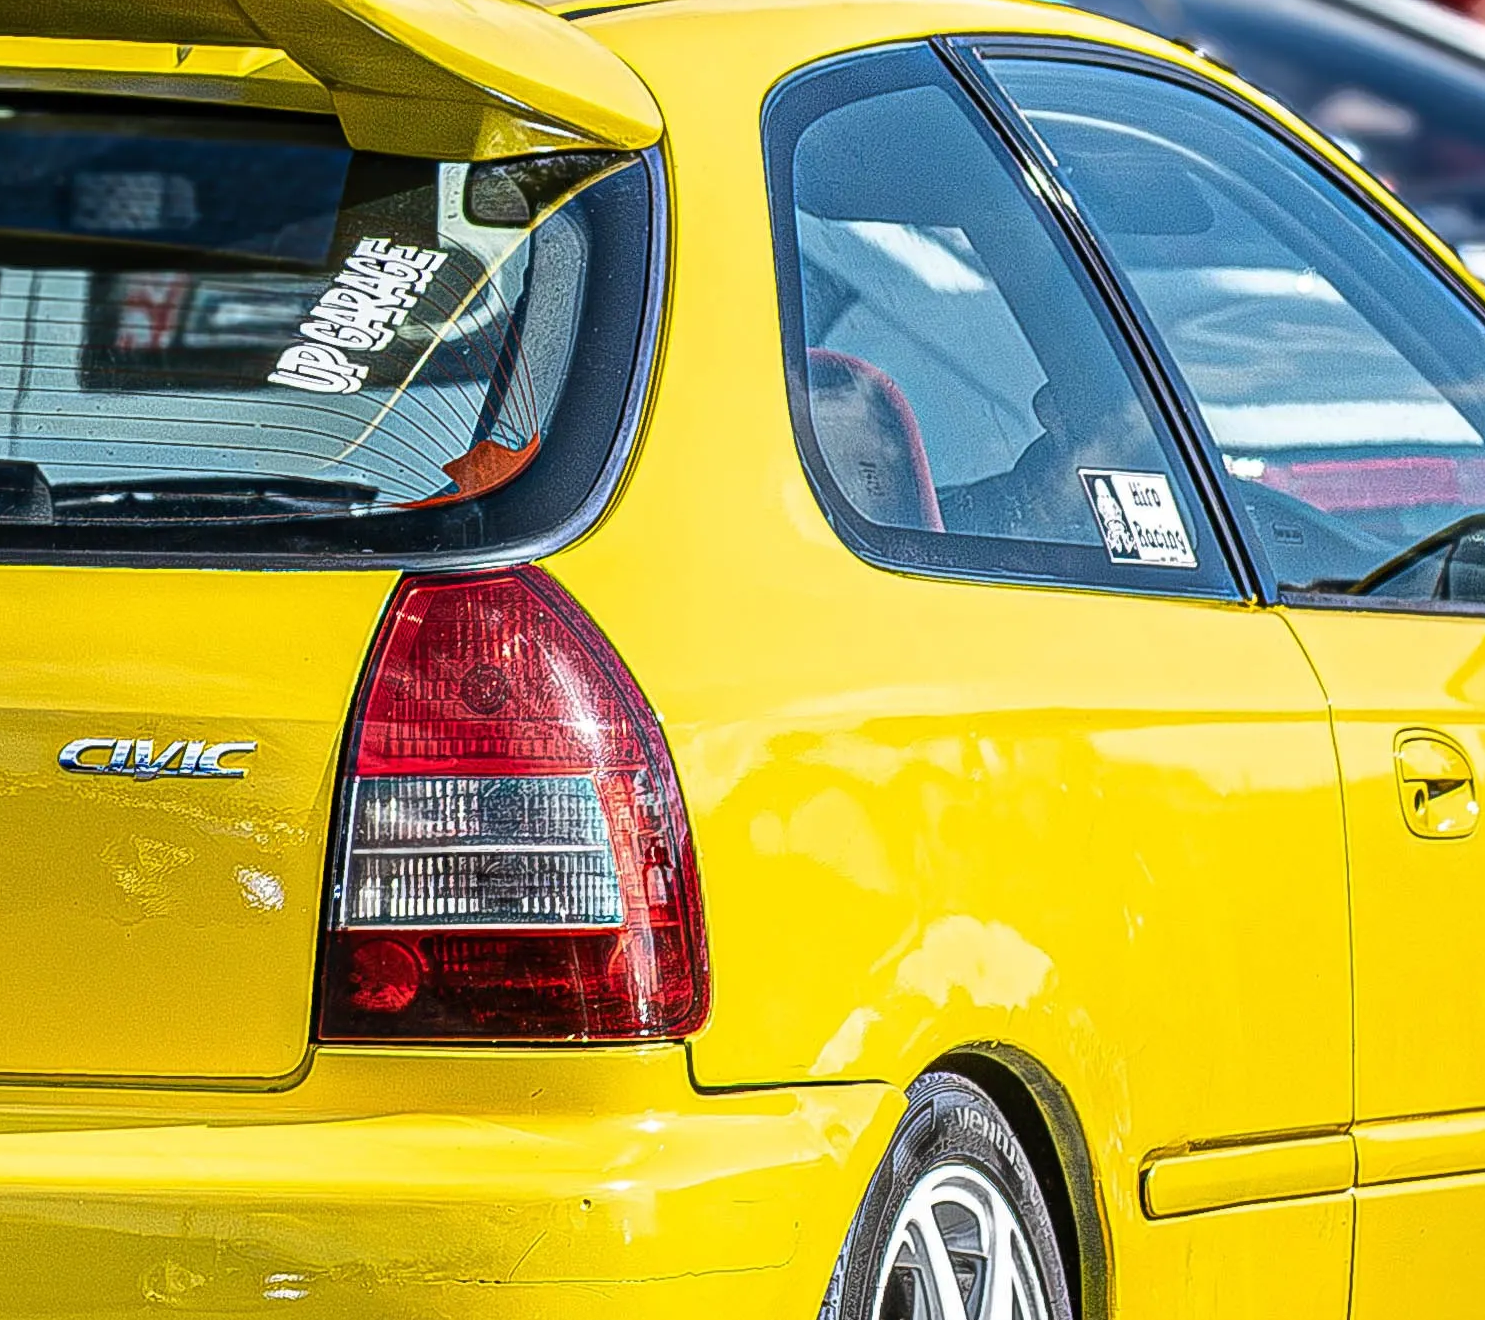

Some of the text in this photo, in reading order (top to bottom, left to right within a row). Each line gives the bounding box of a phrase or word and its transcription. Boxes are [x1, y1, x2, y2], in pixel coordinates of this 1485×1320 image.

[268, 237, 448, 394] UP GARAGE
[1128, 482, 1161, 508] Hiro
[1133, 521, 1187, 555] Racing
[58, 737, 258, 780] CIVIC
